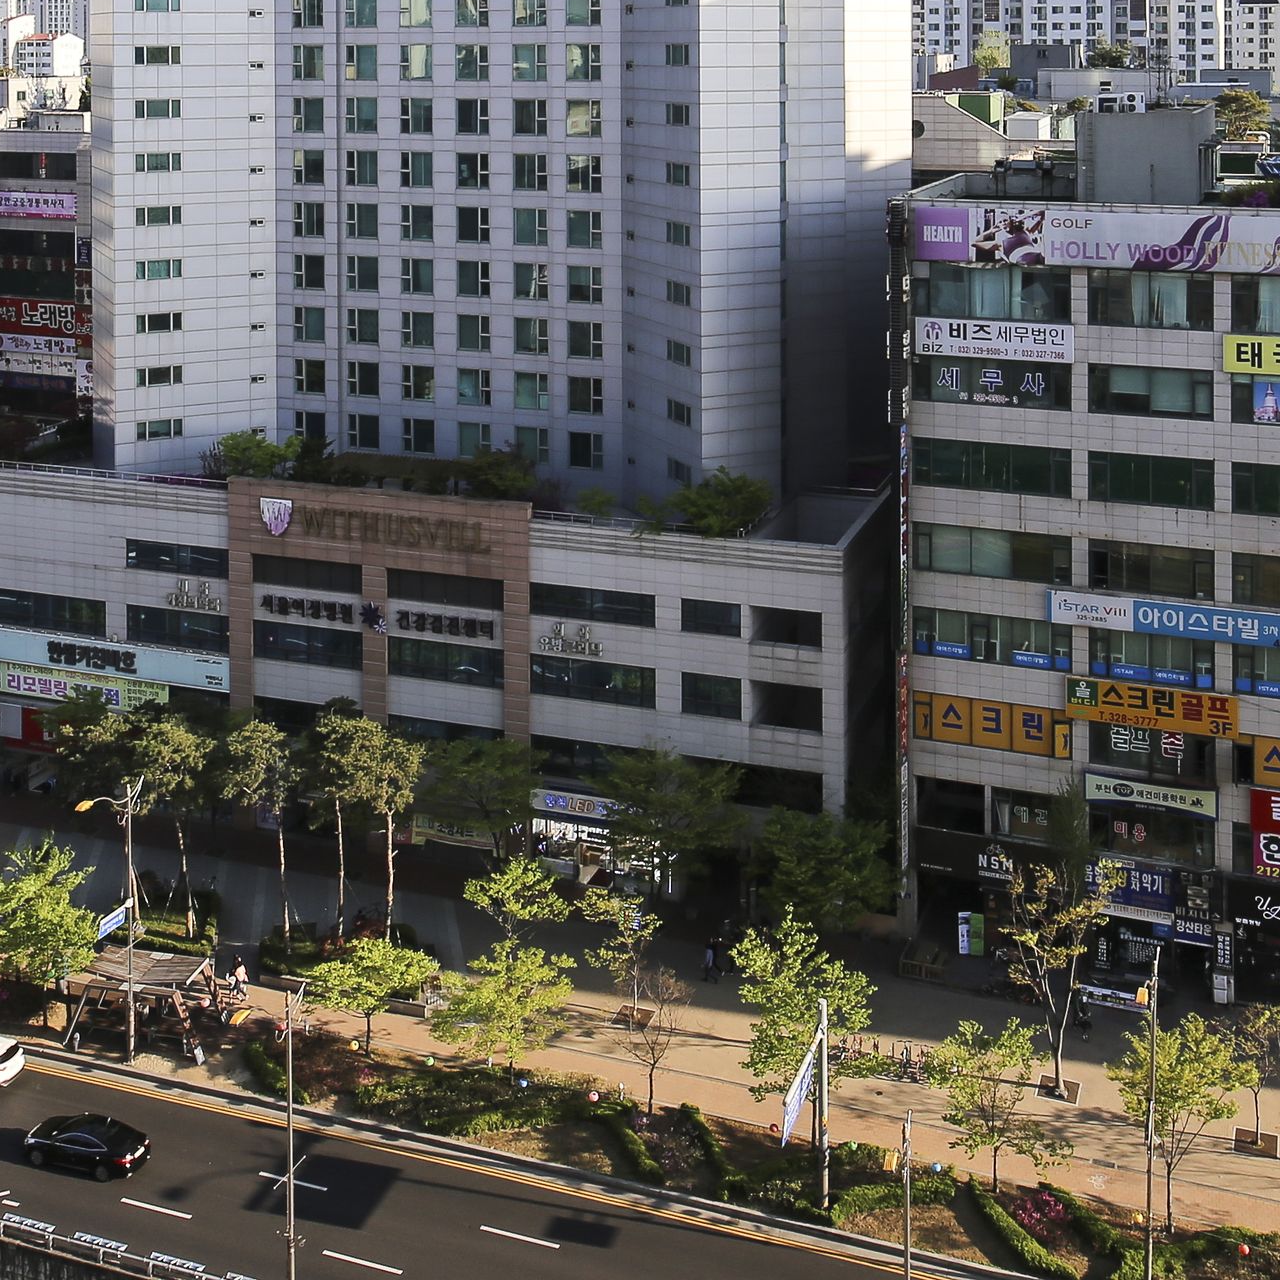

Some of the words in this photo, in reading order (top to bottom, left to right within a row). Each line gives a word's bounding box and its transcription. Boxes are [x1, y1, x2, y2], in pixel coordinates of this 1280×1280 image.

[923, 225, 962, 243] HEALTH
[1051, 217, 1093, 230] GOLF
[1050, 240, 1120, 261] HOLLY
[1128, 243, 1196, 264] WOOD
[21, 302, 75, 334] 노래방
[949, 322, 993, 342] 비즈
[996, 325, 1065, 347] 세무법인
[1035, 350, 1065, 360] 327-7366
[937, 367, 1045, 397] 세무사
[299, 505, 492, 555] WITHUSVILL
[1138, 606, 1259, 641] 아이스타빌
[7, 673, 68, 700] 리모델링
[942, 702, 1044, 741] 스크린
[1209, 720, 1233, 737] 3F
[1095, 783, 1112, 794] 부천
[1136, 789, 1187, 805] 애견미용학원
[567, 797, 595, 813] LED
[1114, 820, 1147, 841] 미용
[978, 854, 1013, 871] NSM
[1142, 873, 1163, 894] 악기
[1176, 920, 1212, 937] 강산타운
